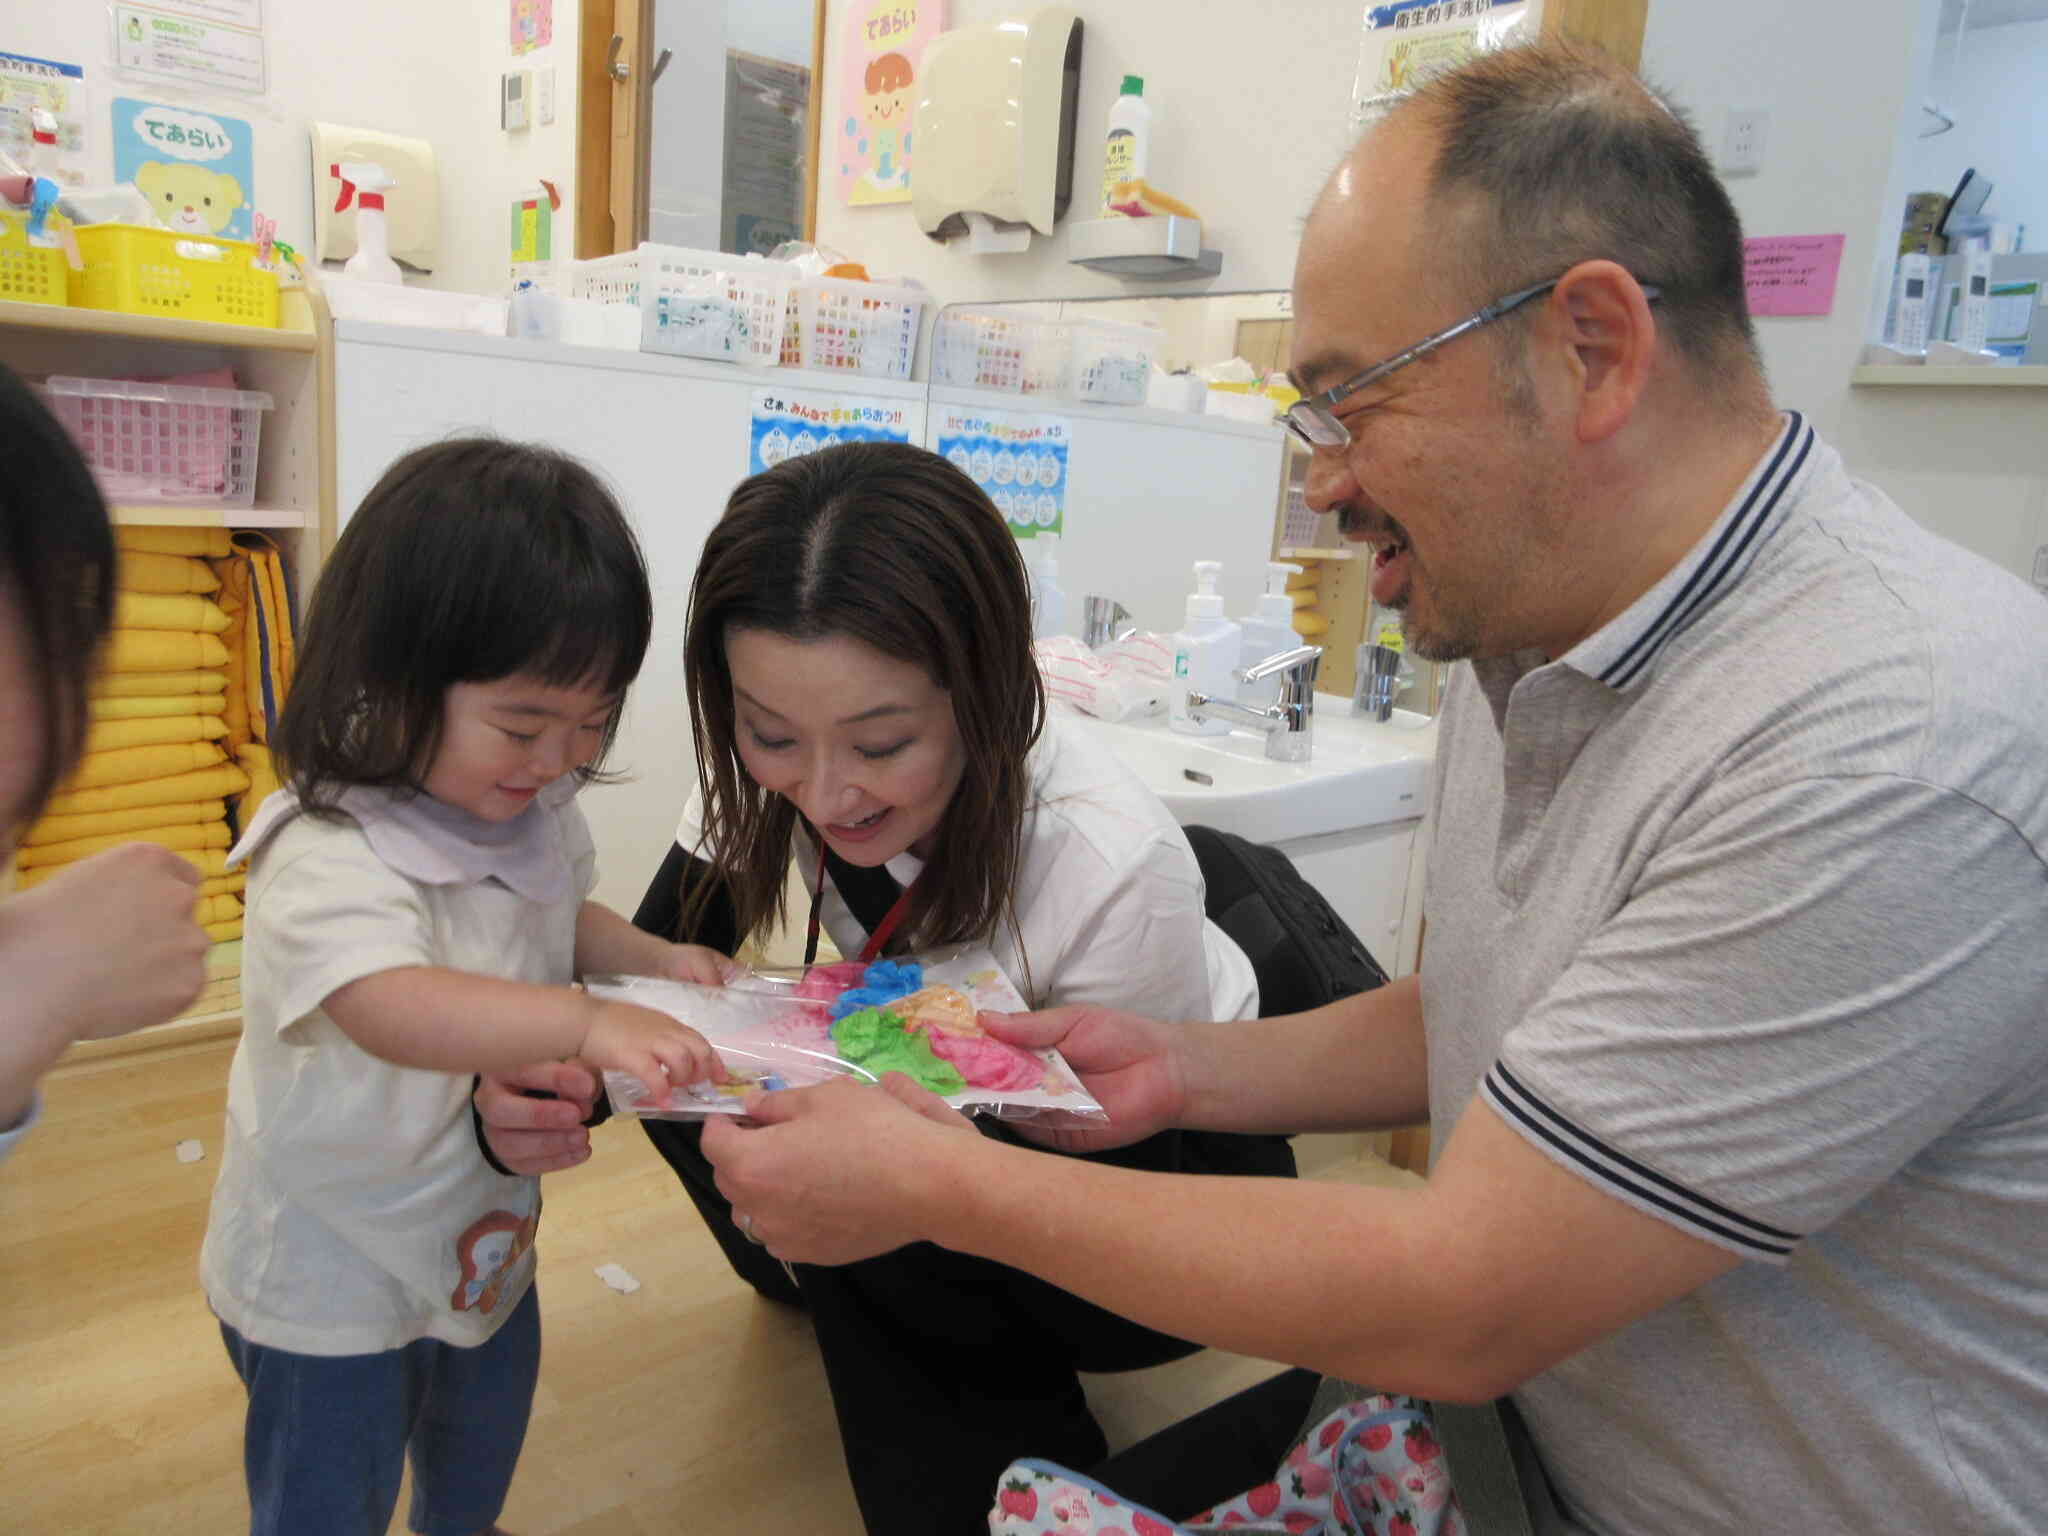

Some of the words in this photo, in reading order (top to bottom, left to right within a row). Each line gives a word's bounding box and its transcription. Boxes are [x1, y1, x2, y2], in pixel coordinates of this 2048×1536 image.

[866, 8, 916, 40] てあらい
[1397, 0, 1490, 30] 衛生的手洗い
[145, 120, 224, 150] てあらい
